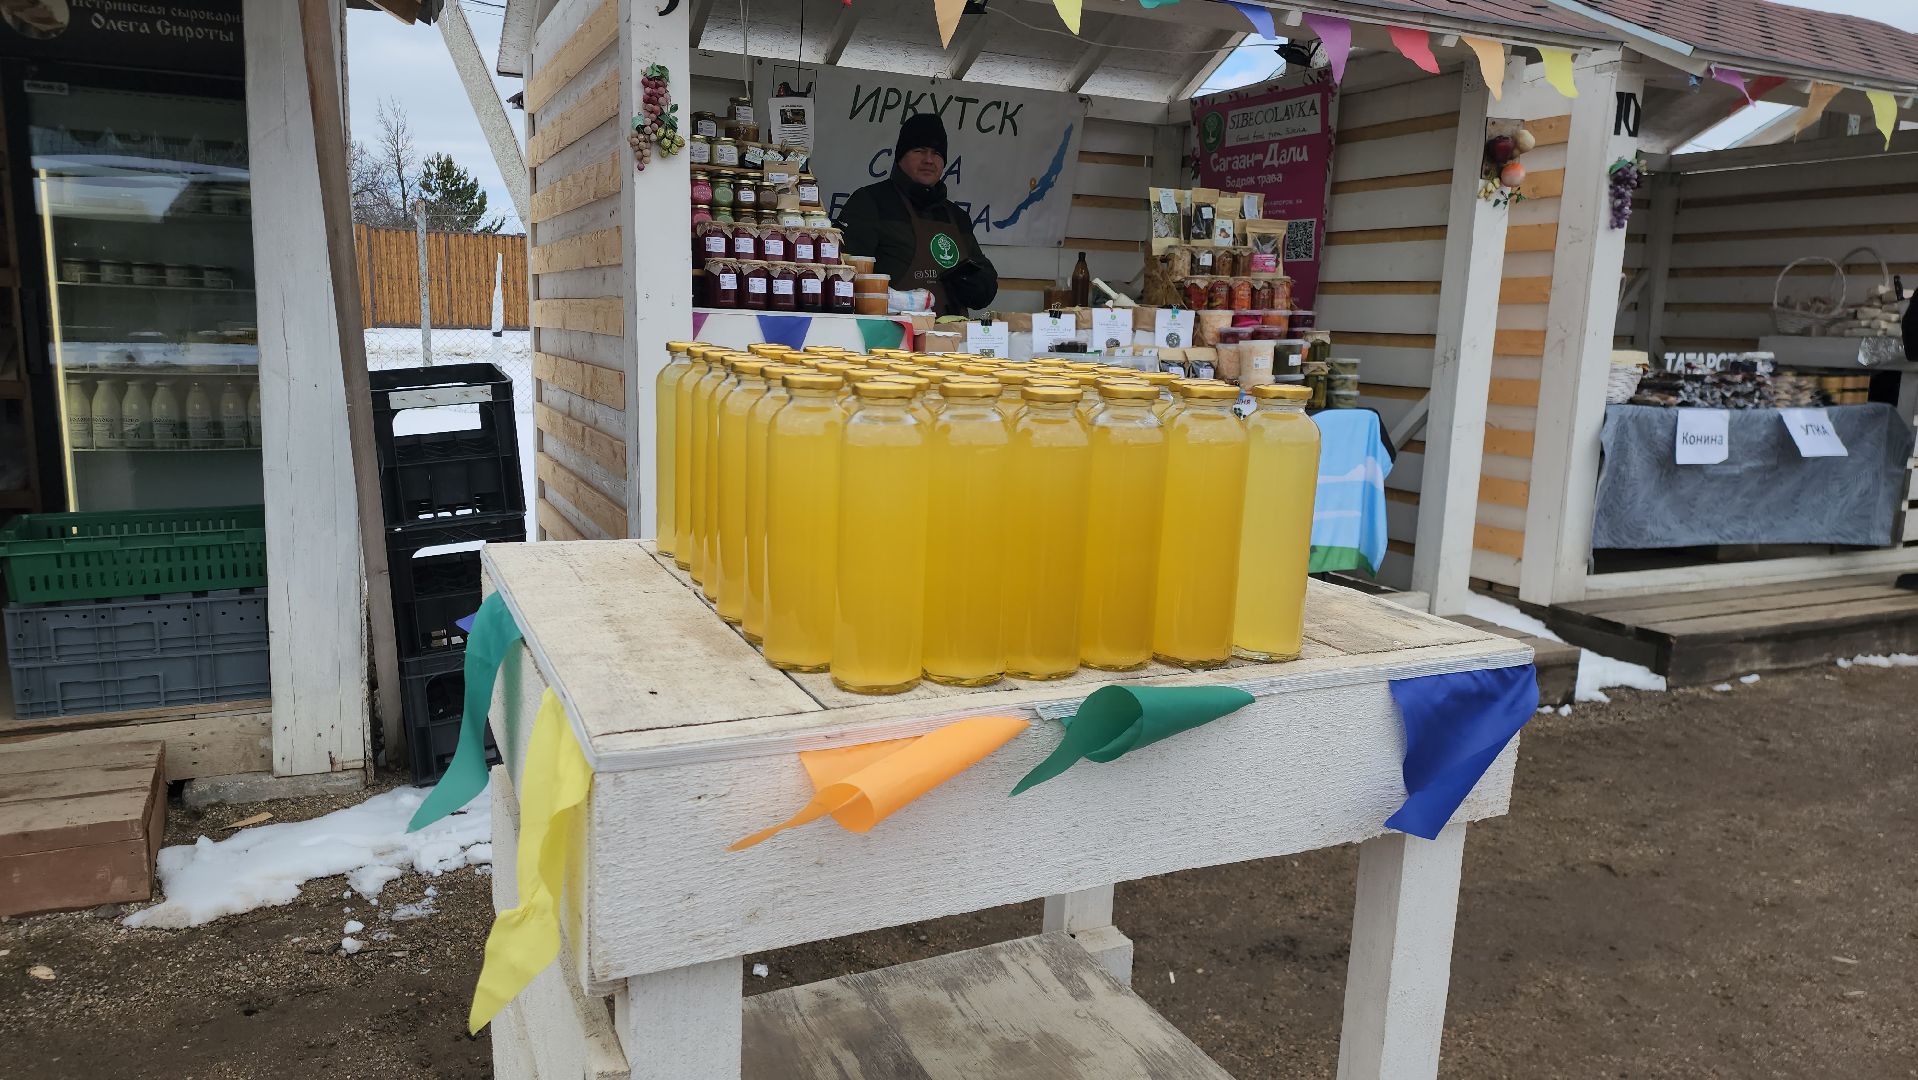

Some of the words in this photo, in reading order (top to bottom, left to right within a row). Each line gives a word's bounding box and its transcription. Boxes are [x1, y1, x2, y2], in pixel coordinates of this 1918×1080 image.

[91, 12, 151, 34] Олега
[156, 18, 235, 42] Сироты
[849, 84, 1023, 136] ИРКУТСК
[1229, 99, 1319, 130] SIBECOLAVKA
[1614, 92, 1642, 137] 10
[1210, 143, 1309, 172] Сагаан-Дали
[1257, 173, 1283, 187] трава
[1681, 431, 1724, 446] Конина
